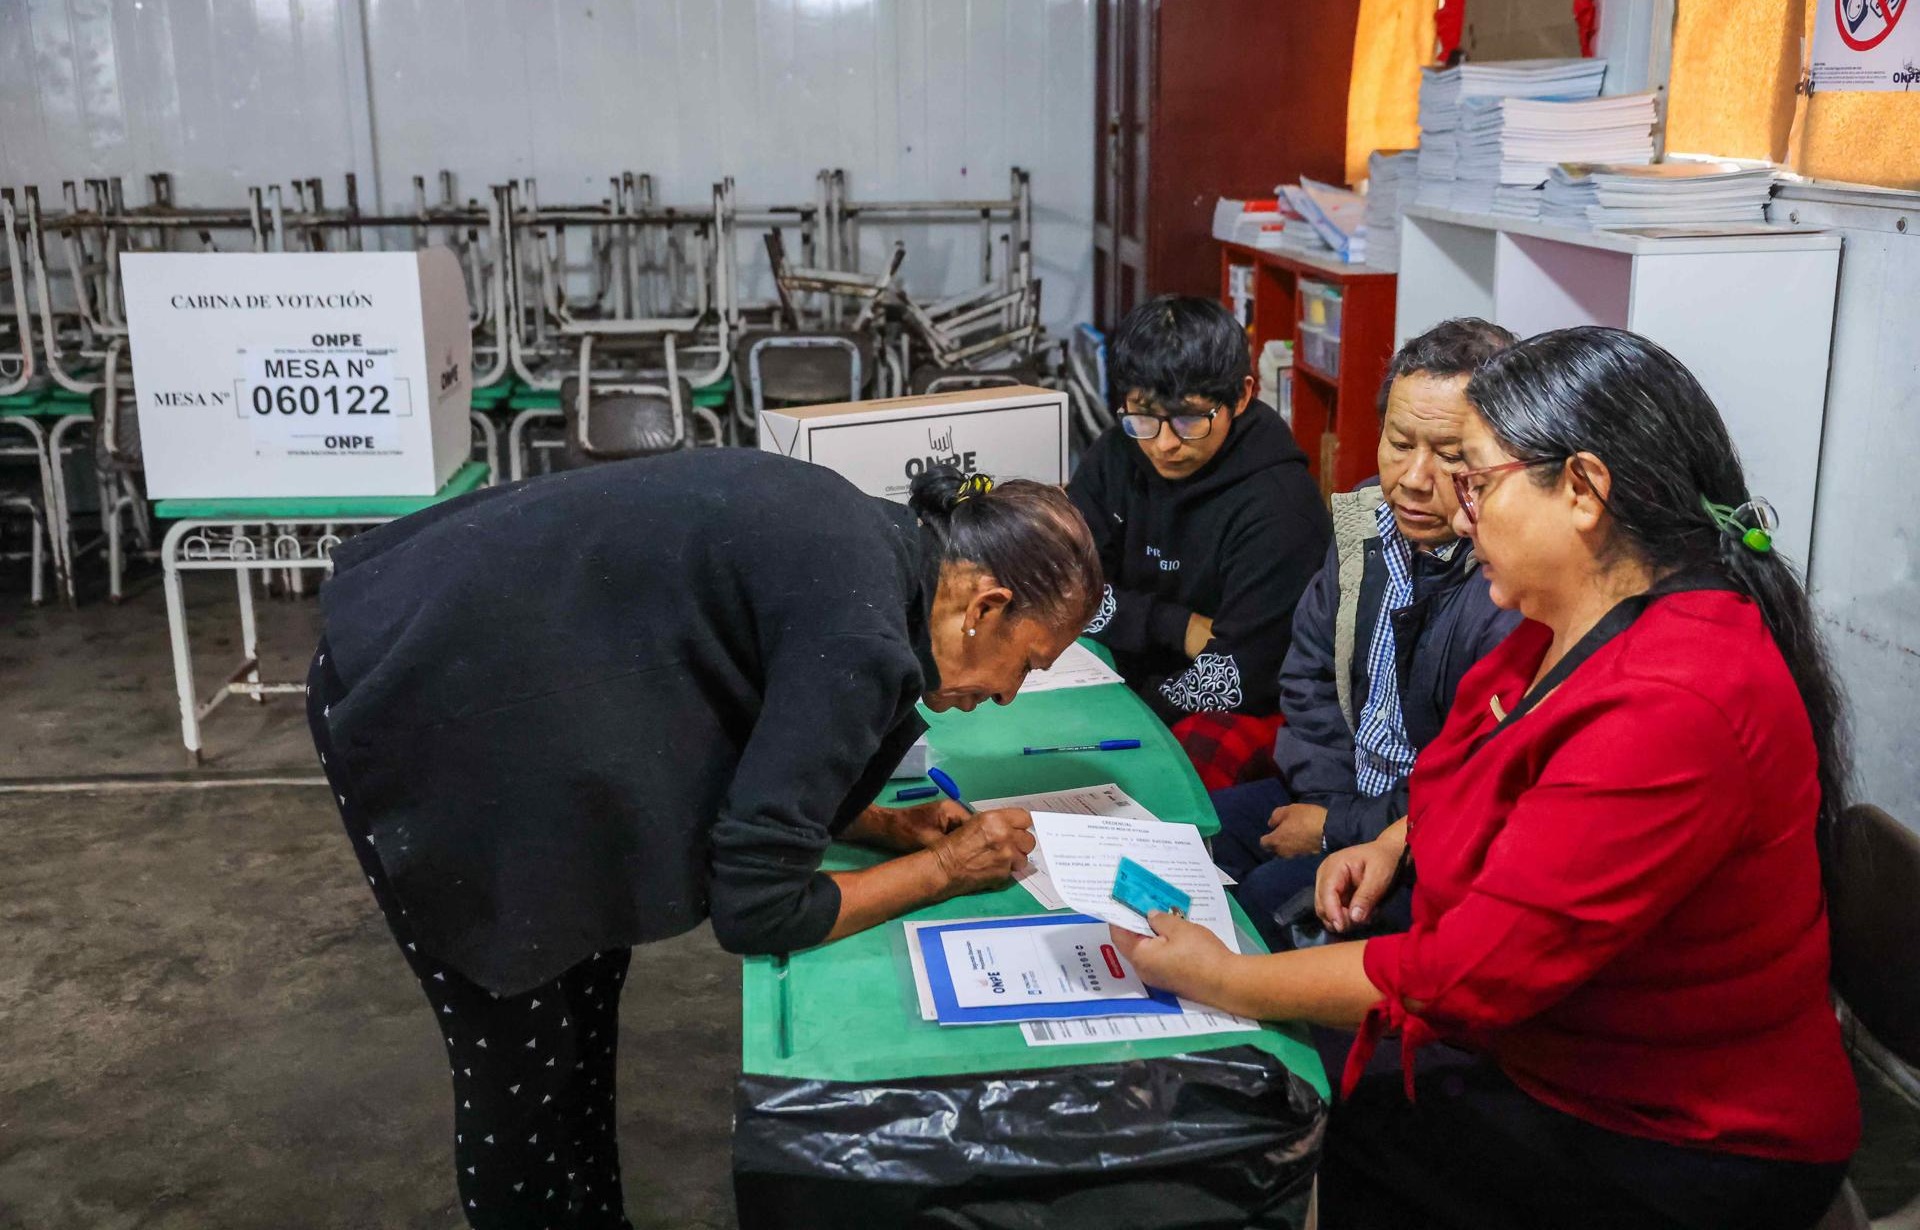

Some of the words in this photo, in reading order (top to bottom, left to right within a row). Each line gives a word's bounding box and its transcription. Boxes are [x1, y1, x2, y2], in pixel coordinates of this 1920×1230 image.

[171, 294, 241, 310] CABINA
[246, 294, 271, 309] DE
[276, 291, 373, 309] VOTACIÓN
[312, 334, 363, 347] ONPE
[265, 359, 340, 379] MESA
[154, 392, 207, 406] MESA
[253, 385, 391, 416] 060122
[325, 436, 375, 449] ONPE
[1160, 560, 1180, 571] GIO
[987, 971, 1006, 994] ONPE
